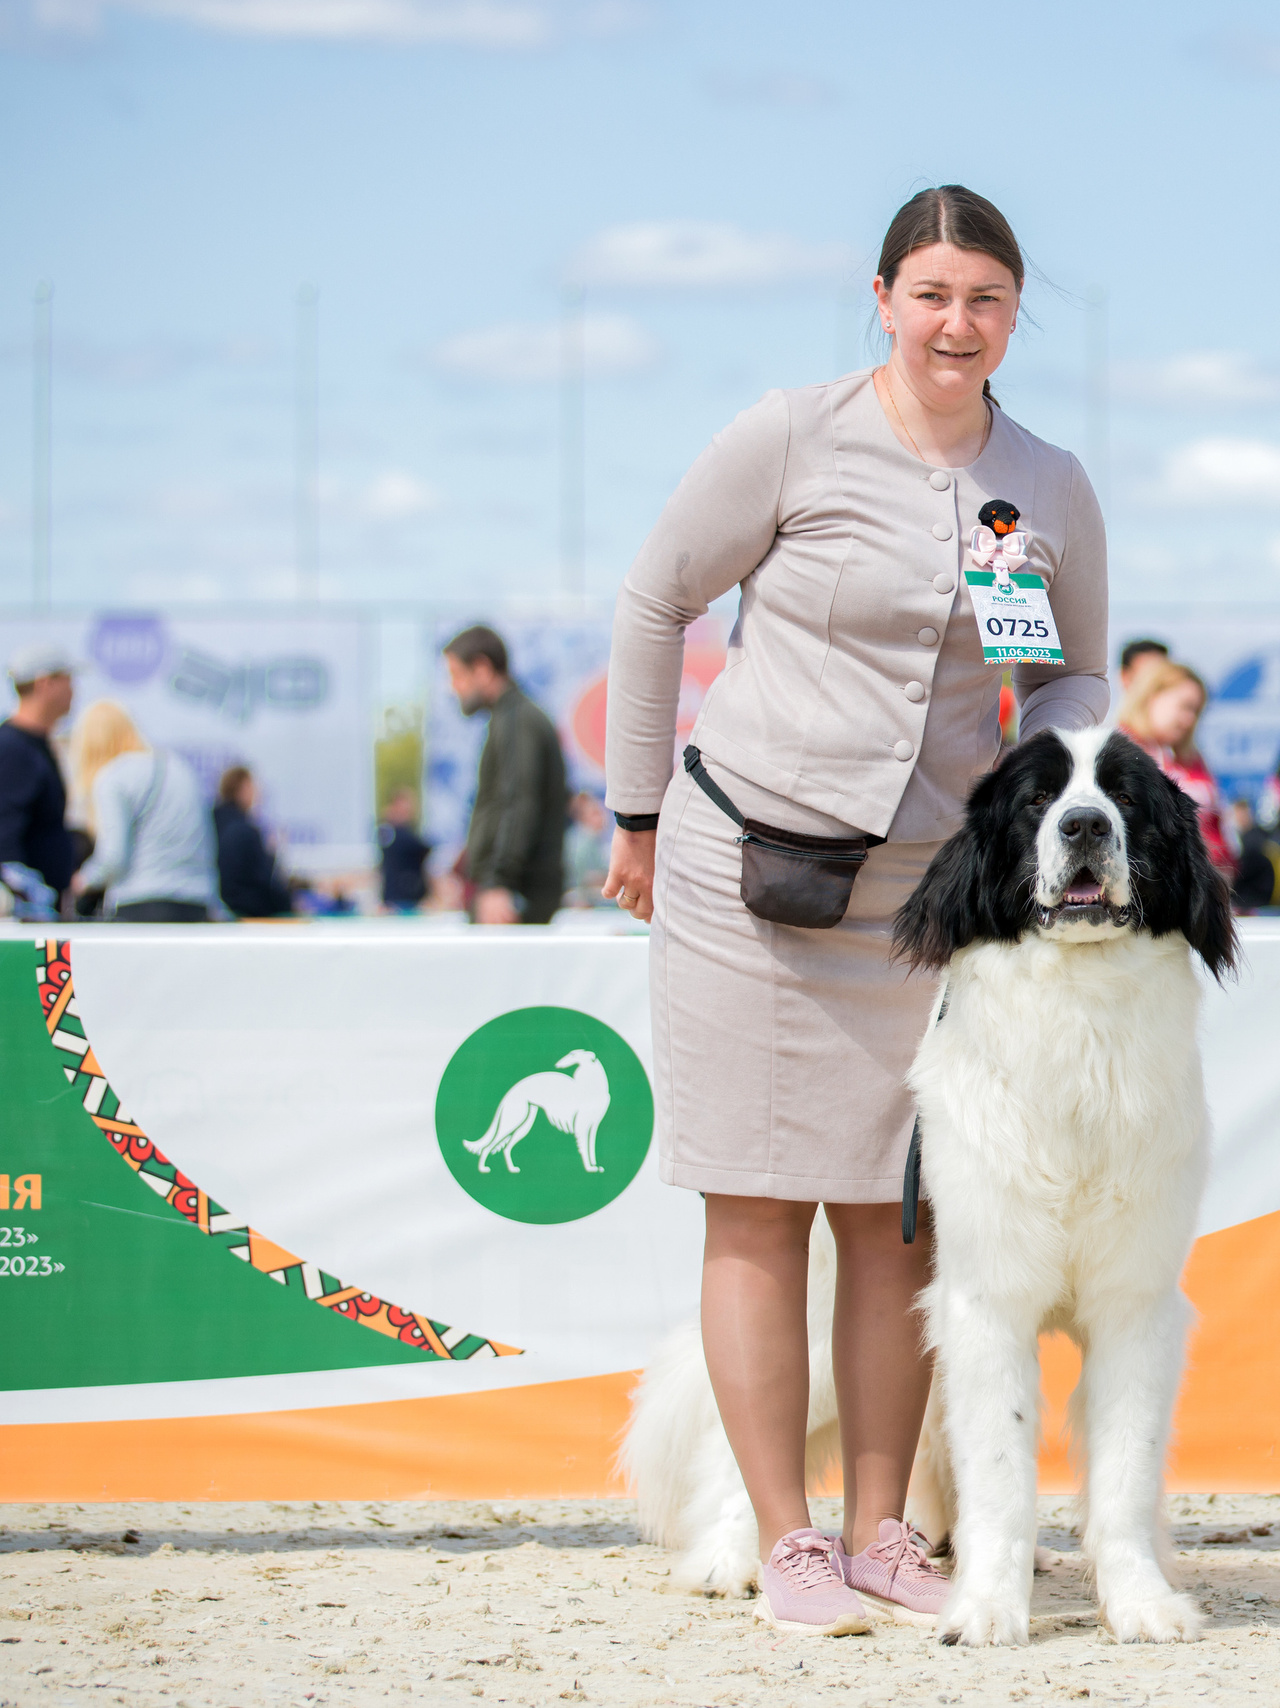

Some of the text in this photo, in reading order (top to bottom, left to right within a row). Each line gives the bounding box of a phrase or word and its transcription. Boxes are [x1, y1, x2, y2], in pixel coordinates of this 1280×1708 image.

[992, 595, 1027, 604] РОССИЯ
[986, 617, 1049, 638] 0725
[996, 647, 1051, 658] 11.06.2023
